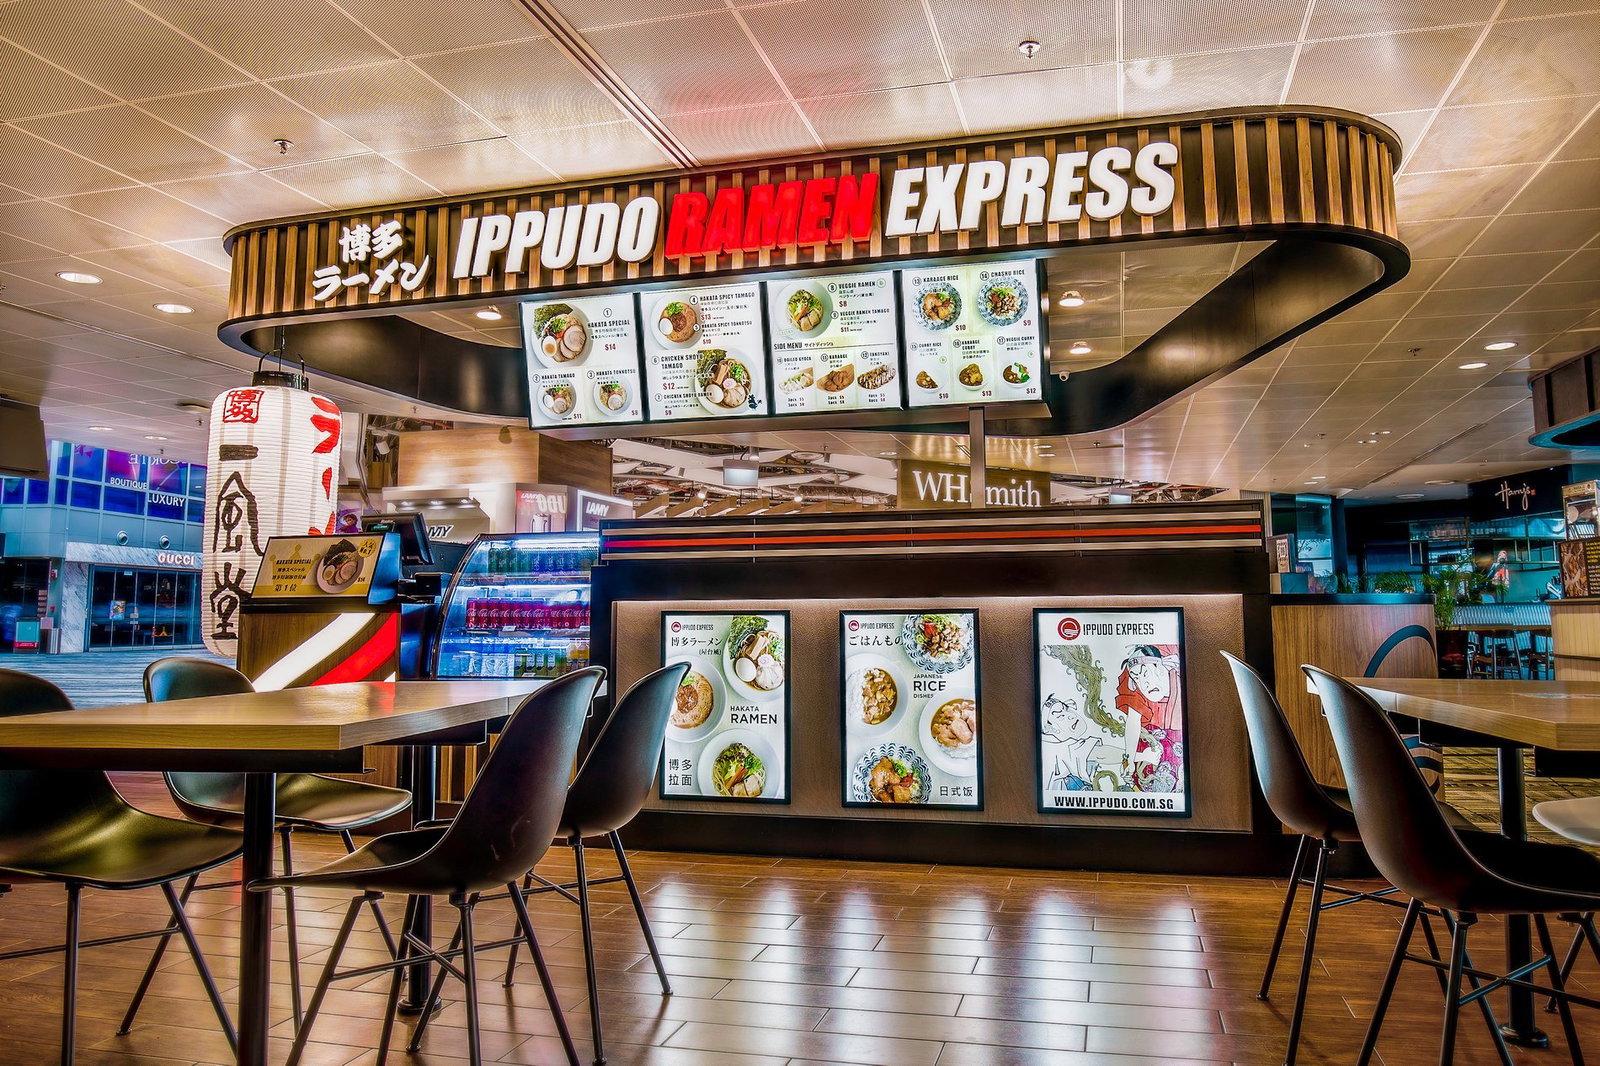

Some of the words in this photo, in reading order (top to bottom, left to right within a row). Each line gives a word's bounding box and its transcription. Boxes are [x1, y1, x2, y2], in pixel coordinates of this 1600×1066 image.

[453, 196, 660, 280] IPPUDO
[665, 172, 879, 258] RAMEN
[885, 142, 1179, 238] EXPRESS
[339, 220, 403, 263] 博多
[312, 254, 431, 302] ラーメン
[110, 476, 148, 490] BOUTIQUE
[912, 471, 1042, 507] WHmith
[147, 493, 185, 507] LUXURY
[585, 501, 609, 517] LAMY
[158, 552, 195, 566] GUCCI
[1083, 623, 1113, 635] IPPUDO
[1116, 623, 1154, 635] EXPRESS
[671, 637, 723, 647] 博多ラーメン
[913, 681, 946, 691] RICE
[730, 714, 777, 724] RAMEN
[669, 759, 692, 771] 博多
[669, 774, 692, 786] 拉面
[939, 786, 973, 797] 日式饭
[1054, 796, 1174, 810] WWW.IPPUDO.COM.SG
